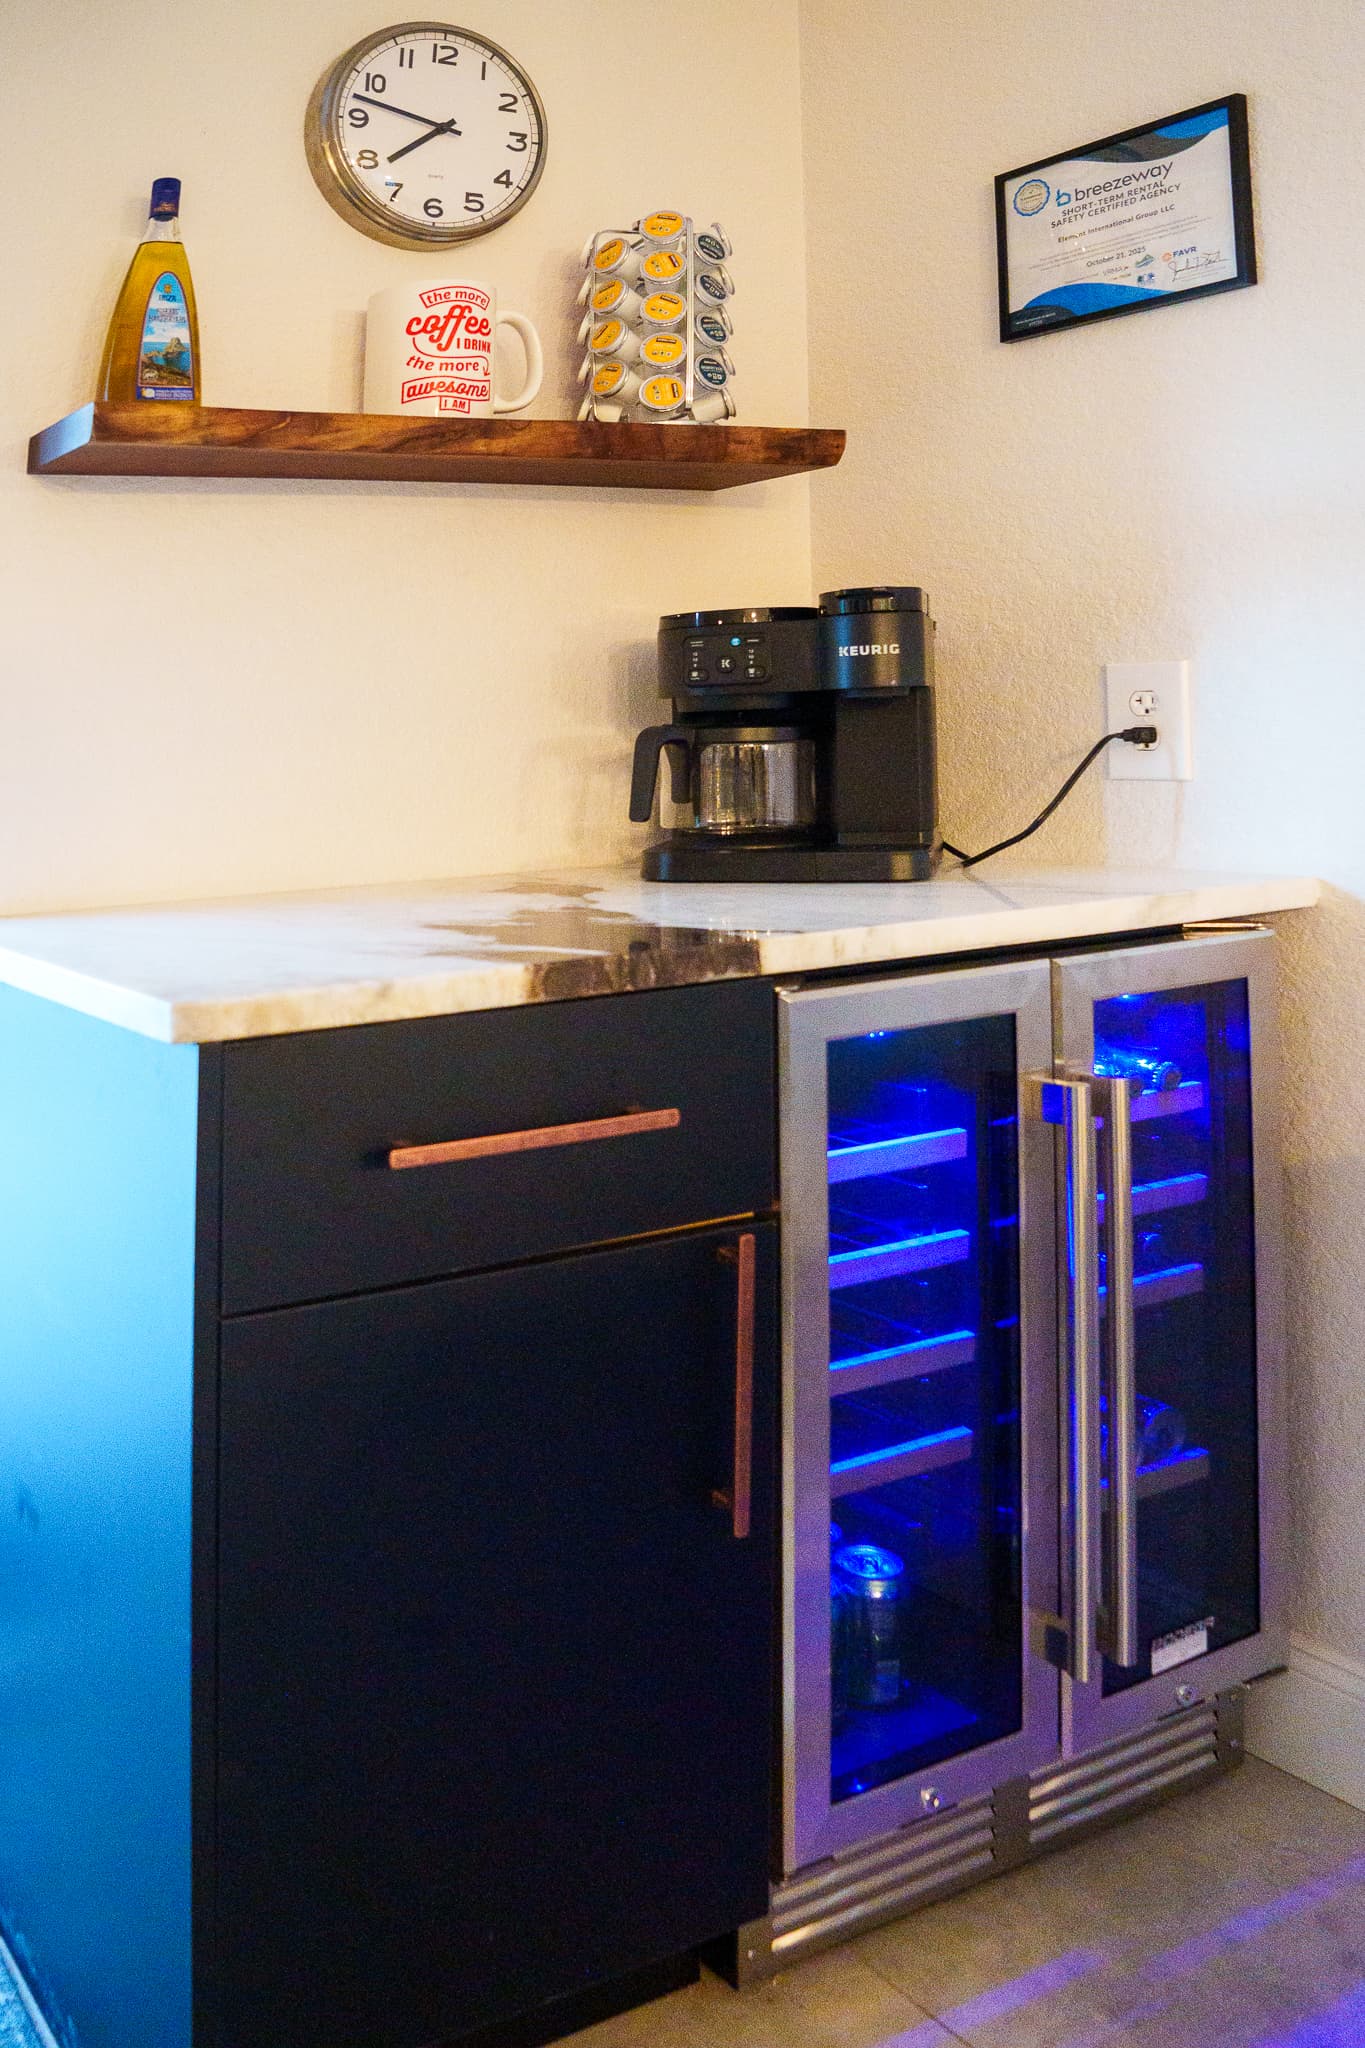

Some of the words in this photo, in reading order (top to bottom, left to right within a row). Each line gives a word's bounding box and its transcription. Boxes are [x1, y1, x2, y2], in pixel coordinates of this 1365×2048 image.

[399, 47, 414, 69] 11
[432, 43, 459, 66] 12
[481, 61, 487, 81] 1
[365, 72, 386, 93] 10
[498, 93, 519, 113] 2
[348, 107, 369, 129] 9
[506, 131, 528, 152] 3
[356, 149, 379, 169] 8
[493, 169, 514, 189] 4
[1074, 161, 1173, 201] breezeway
[384, 181, 404, 202] 7
[1061, 193, 1124, 217] SHORT-TERM
[1127, 180, 1165, 197] RENTAL
[423, 198, 444, 218] 6
[463, 191, 485, 213] 5
[1051, 213, 1085, 229] SAFETY
[1088, 197, 1137, 217] CERTIFIED
[1139, 183, 1181, 202] AGENCY
[1088, 216, 1134, 233] International
[1135, 209, 1159, 221] Group
[1161, 204, 1176, 213] LLC
[1086, 255, 1114, 267] October
[427, 291, 450, 303] the
[455, 291, 486, 305] more
[405, 304, 492, 352] coffee
[456, 337, 461, 349] I
[464, 338, 491, 353] DRINK
[406, 355, 435, 371] the
[439, 361, 479, 371] more
[407, 381, 488, 397] awesome
[444, 399, 448, 408] I
[451, 400, 466, 409] AM
[838, 643, 901, 657] KEURIG
